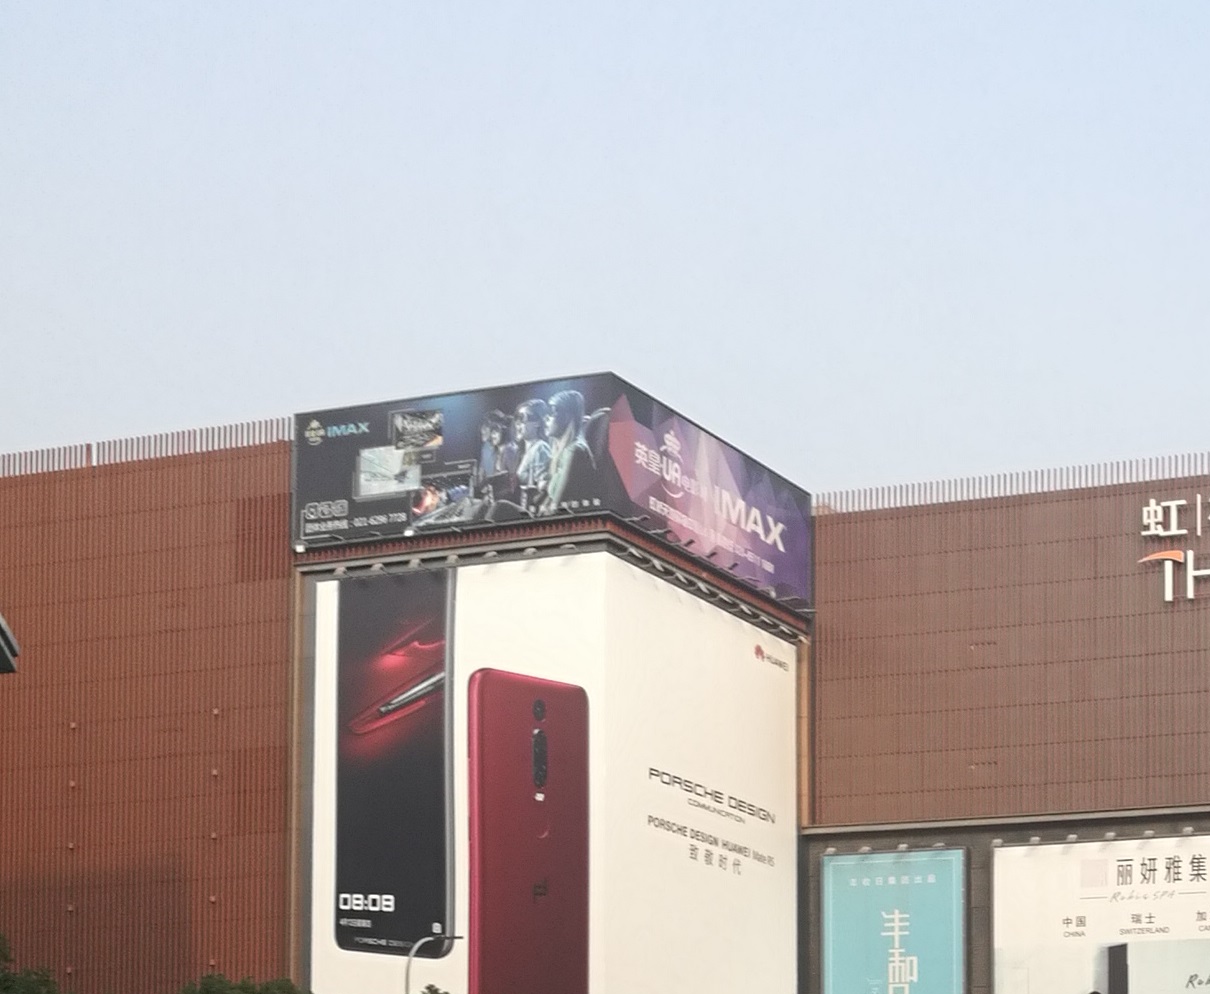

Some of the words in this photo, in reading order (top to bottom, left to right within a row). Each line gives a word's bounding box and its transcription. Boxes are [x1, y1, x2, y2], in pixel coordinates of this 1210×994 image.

[327, 422, 370, 438] IMAX
[714, 485, 786, 553] IMAX
[765, 652, 789, 672] HUAWEI
[648, 767, 724, 804] PORSCHE
[727, 796, 776, 824] DESIGN
[647, 815, 688, 838] PORSCHE
[689, 828, 719, 848] DESIGN
[721, 838, 751, 859] HUAWEI
[1116, 854, 1208, 886] 丽妍雅集
[339, 893, 395, 912] 08:08
[1062, 915, 1087, 928] 中国
[1131, 913, 1156, 925] 瑞士
[1119, 926, 1170, 936] SWITZERLAND
